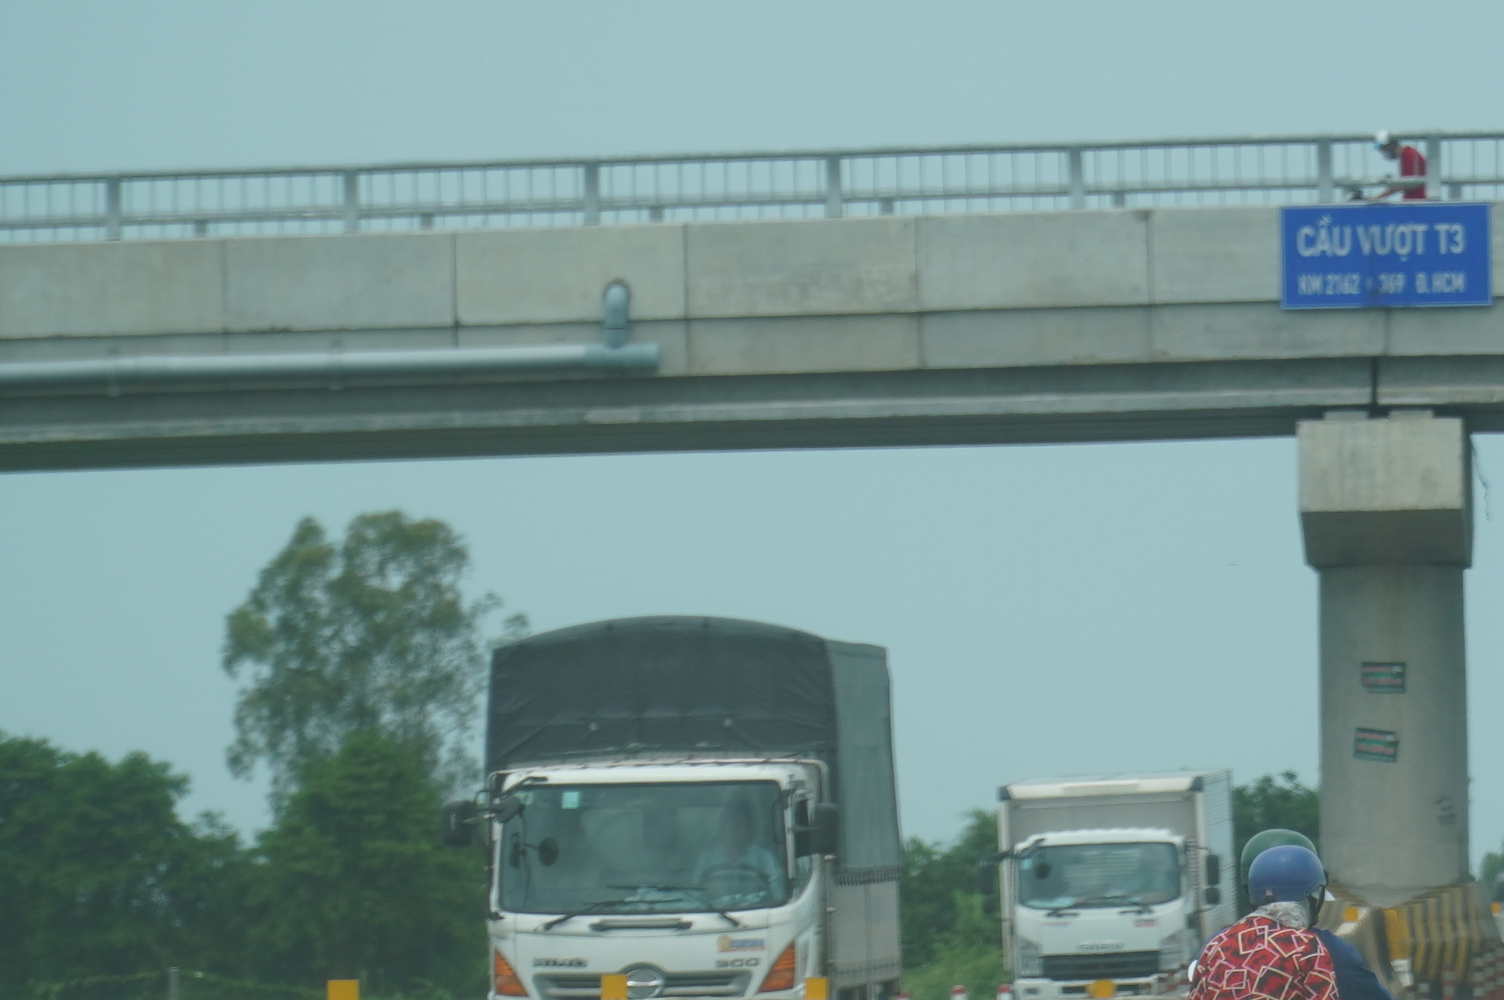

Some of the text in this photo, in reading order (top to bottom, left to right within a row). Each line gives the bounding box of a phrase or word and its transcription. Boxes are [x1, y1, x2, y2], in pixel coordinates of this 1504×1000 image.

[1356, 222, 1429, 262] VƯỢT
[1434, 222, 1466, 255] T3
[1298, 272, 1324, 295] KM
